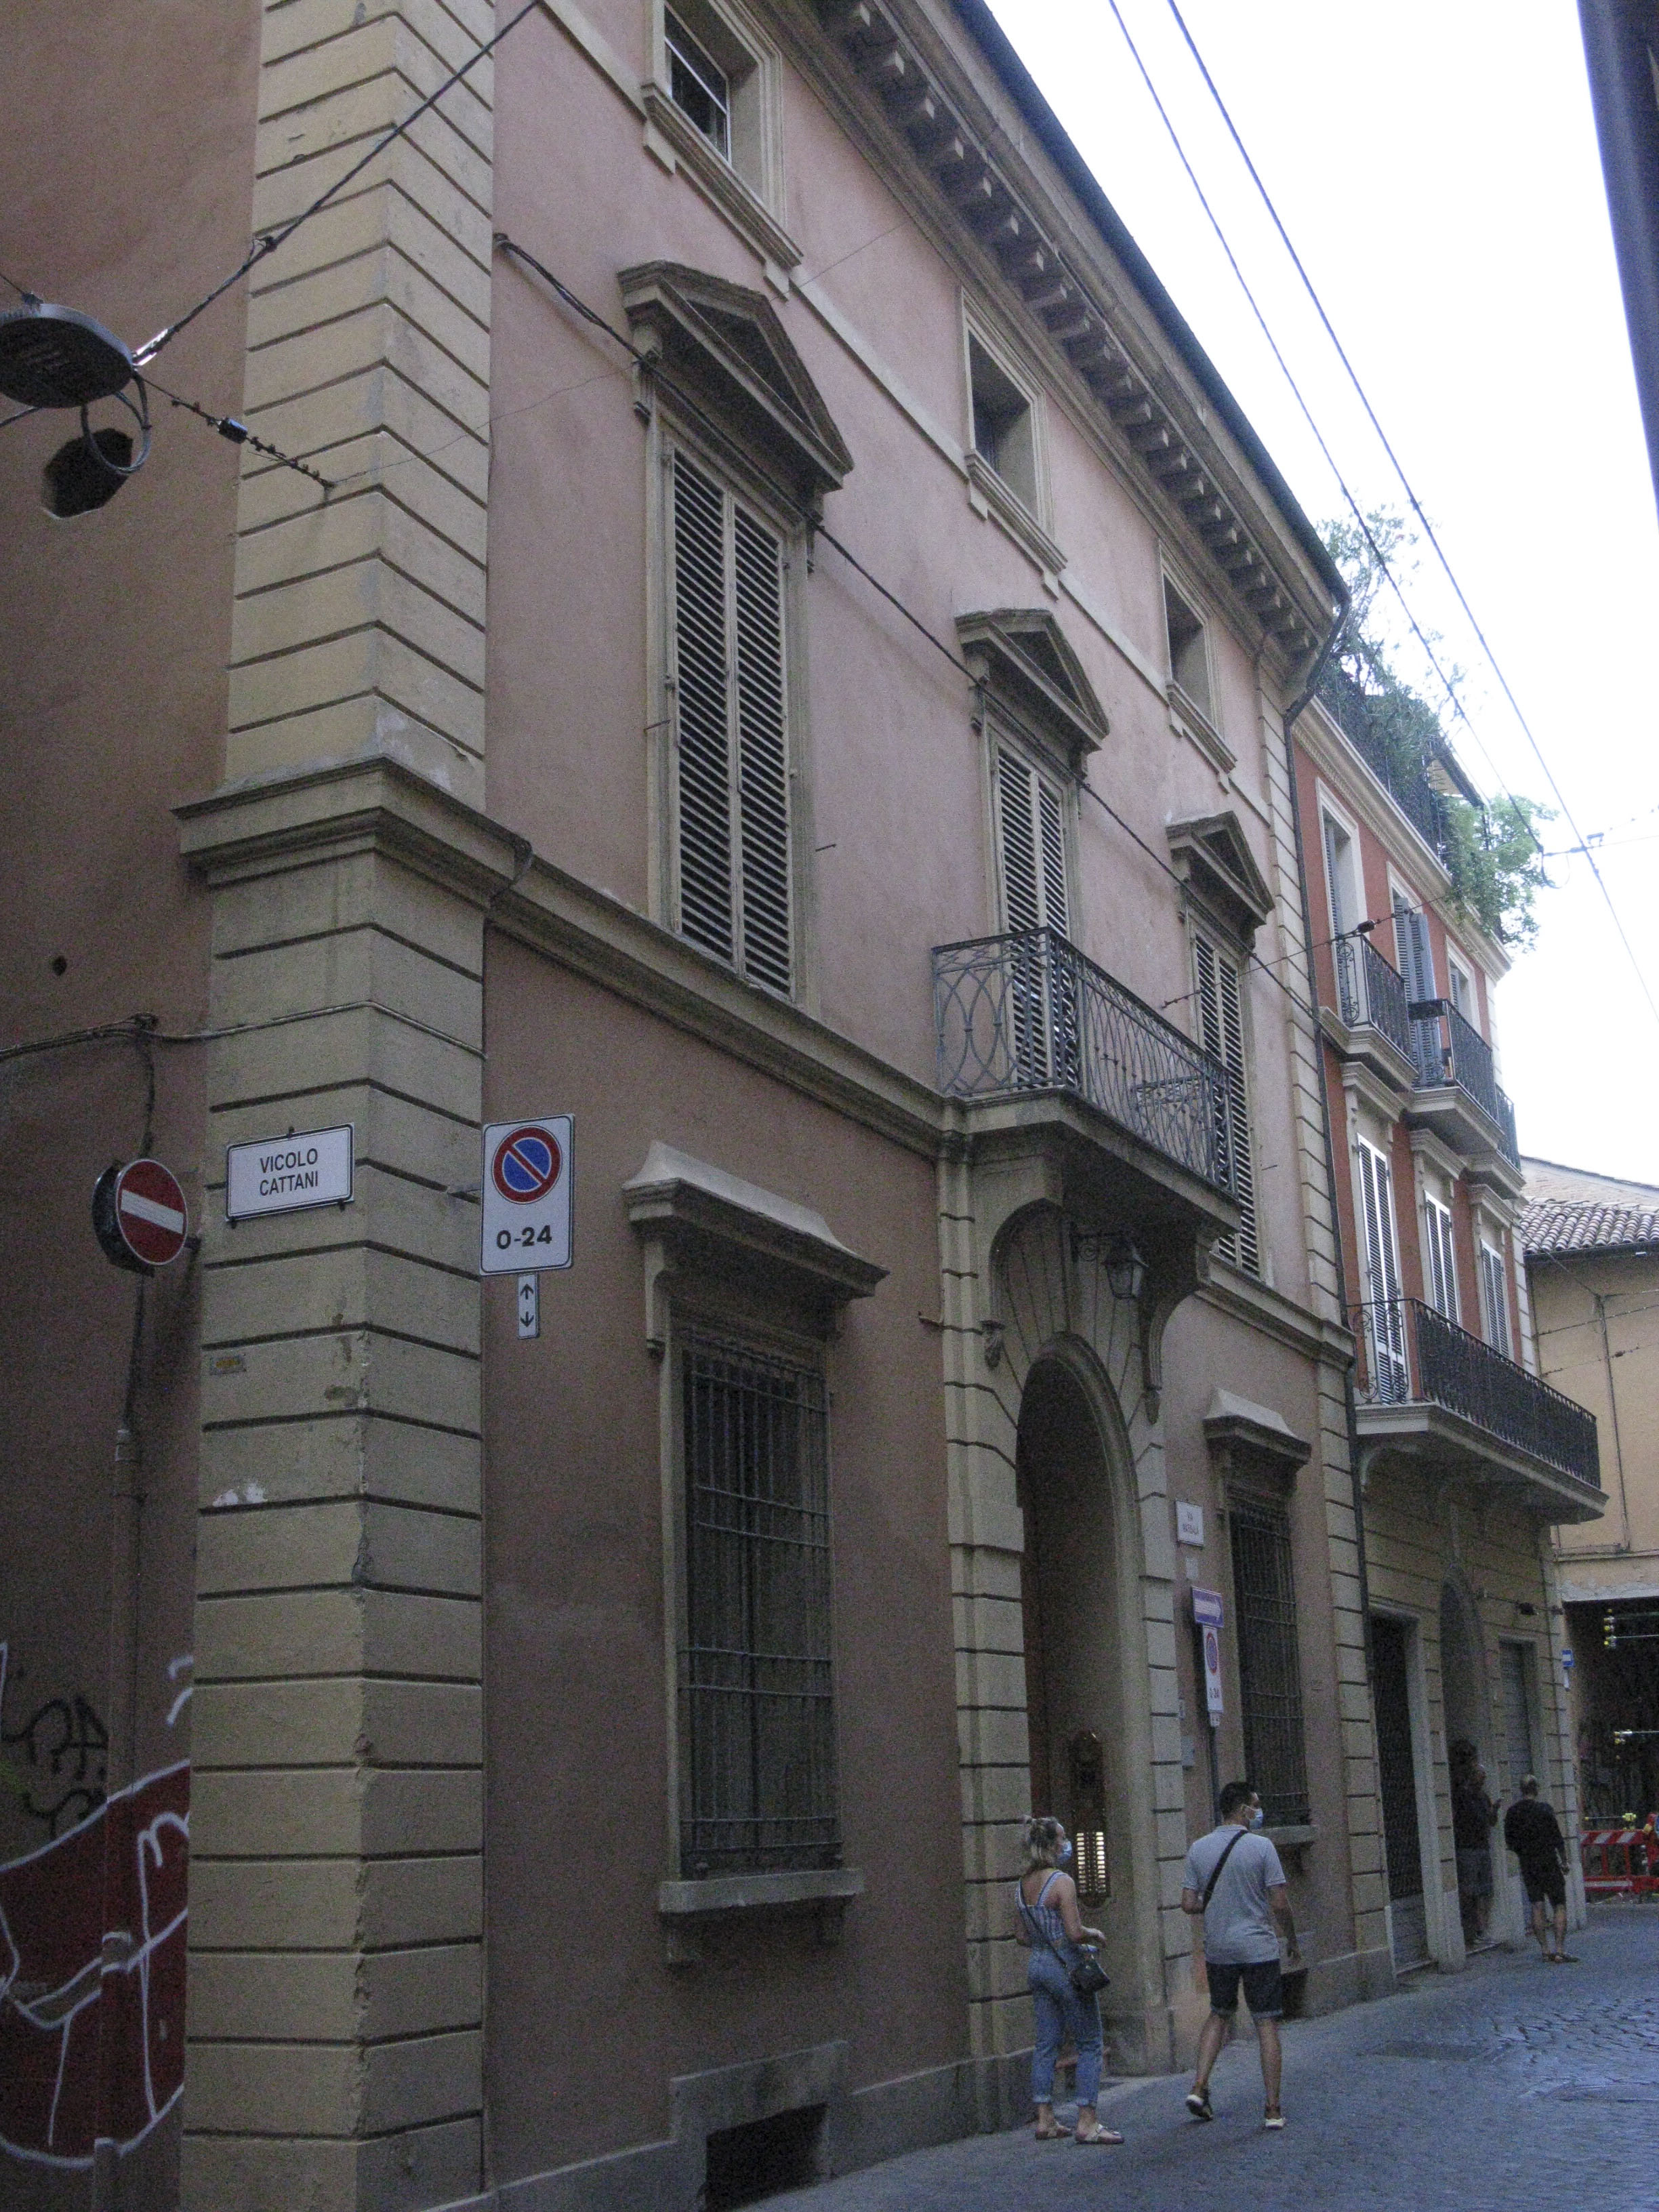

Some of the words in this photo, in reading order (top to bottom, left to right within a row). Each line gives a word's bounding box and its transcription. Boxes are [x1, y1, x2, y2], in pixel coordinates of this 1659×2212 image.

[260, 1147, 318, 1174] VICOLO
[260, 1170, 318, 1196] CATTANI
[497, 1225, 552, 1250] 0-24
